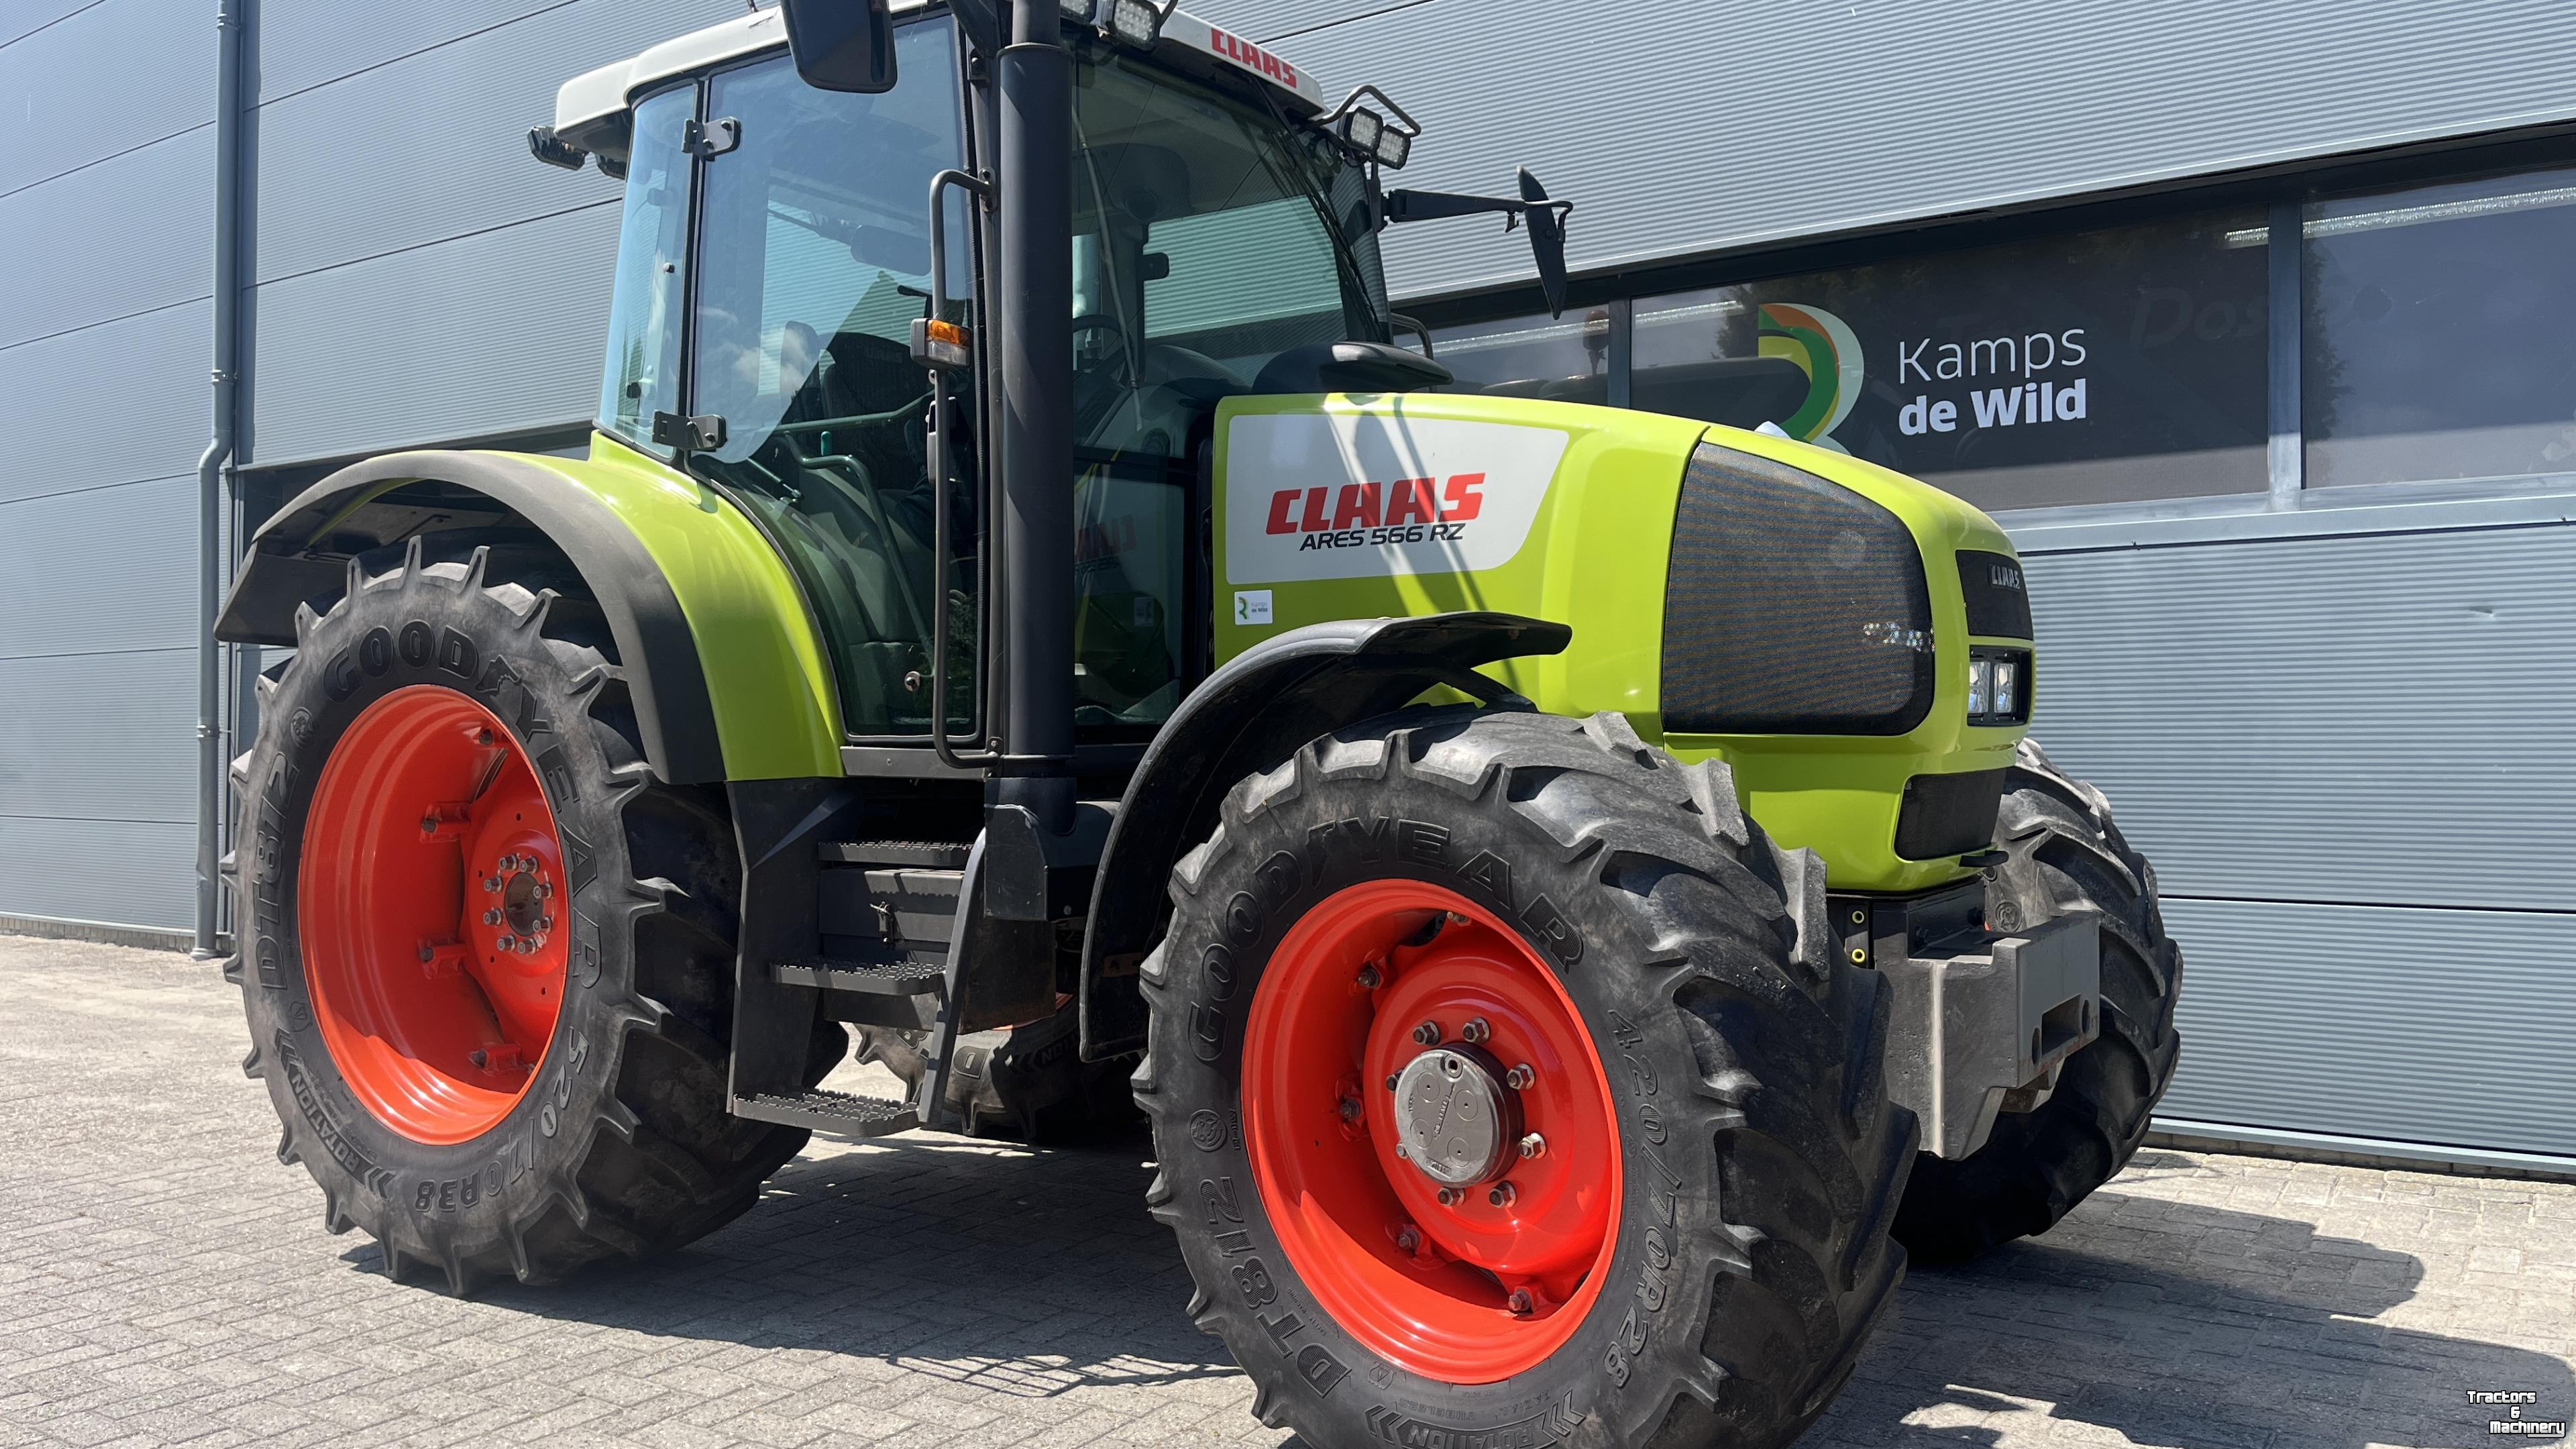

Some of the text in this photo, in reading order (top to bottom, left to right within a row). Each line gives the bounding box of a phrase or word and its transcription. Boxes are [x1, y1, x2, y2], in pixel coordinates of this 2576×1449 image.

[1210, 28, 1297, 89] CLAAS
[1898, 327, 2087, 384] Kamps
[1898, 378, 2087, 435] de Wild
[1266, 472, 1486, 535] CLAAS
[1299, 523, 1466, 551] ARES 566 RZ
[323, 619, 602, 989] GOODYEAR
[1187, 816, 1585, 1062] GOODYEAR
[291, 1075, 359, 1173] ROTATION
[1603, 1009, 1682, 1389] 420/70R28
[1199, 1176, 1352, 1399] DT812
[1399, 1397, 1476, 1421] TUBELESS
